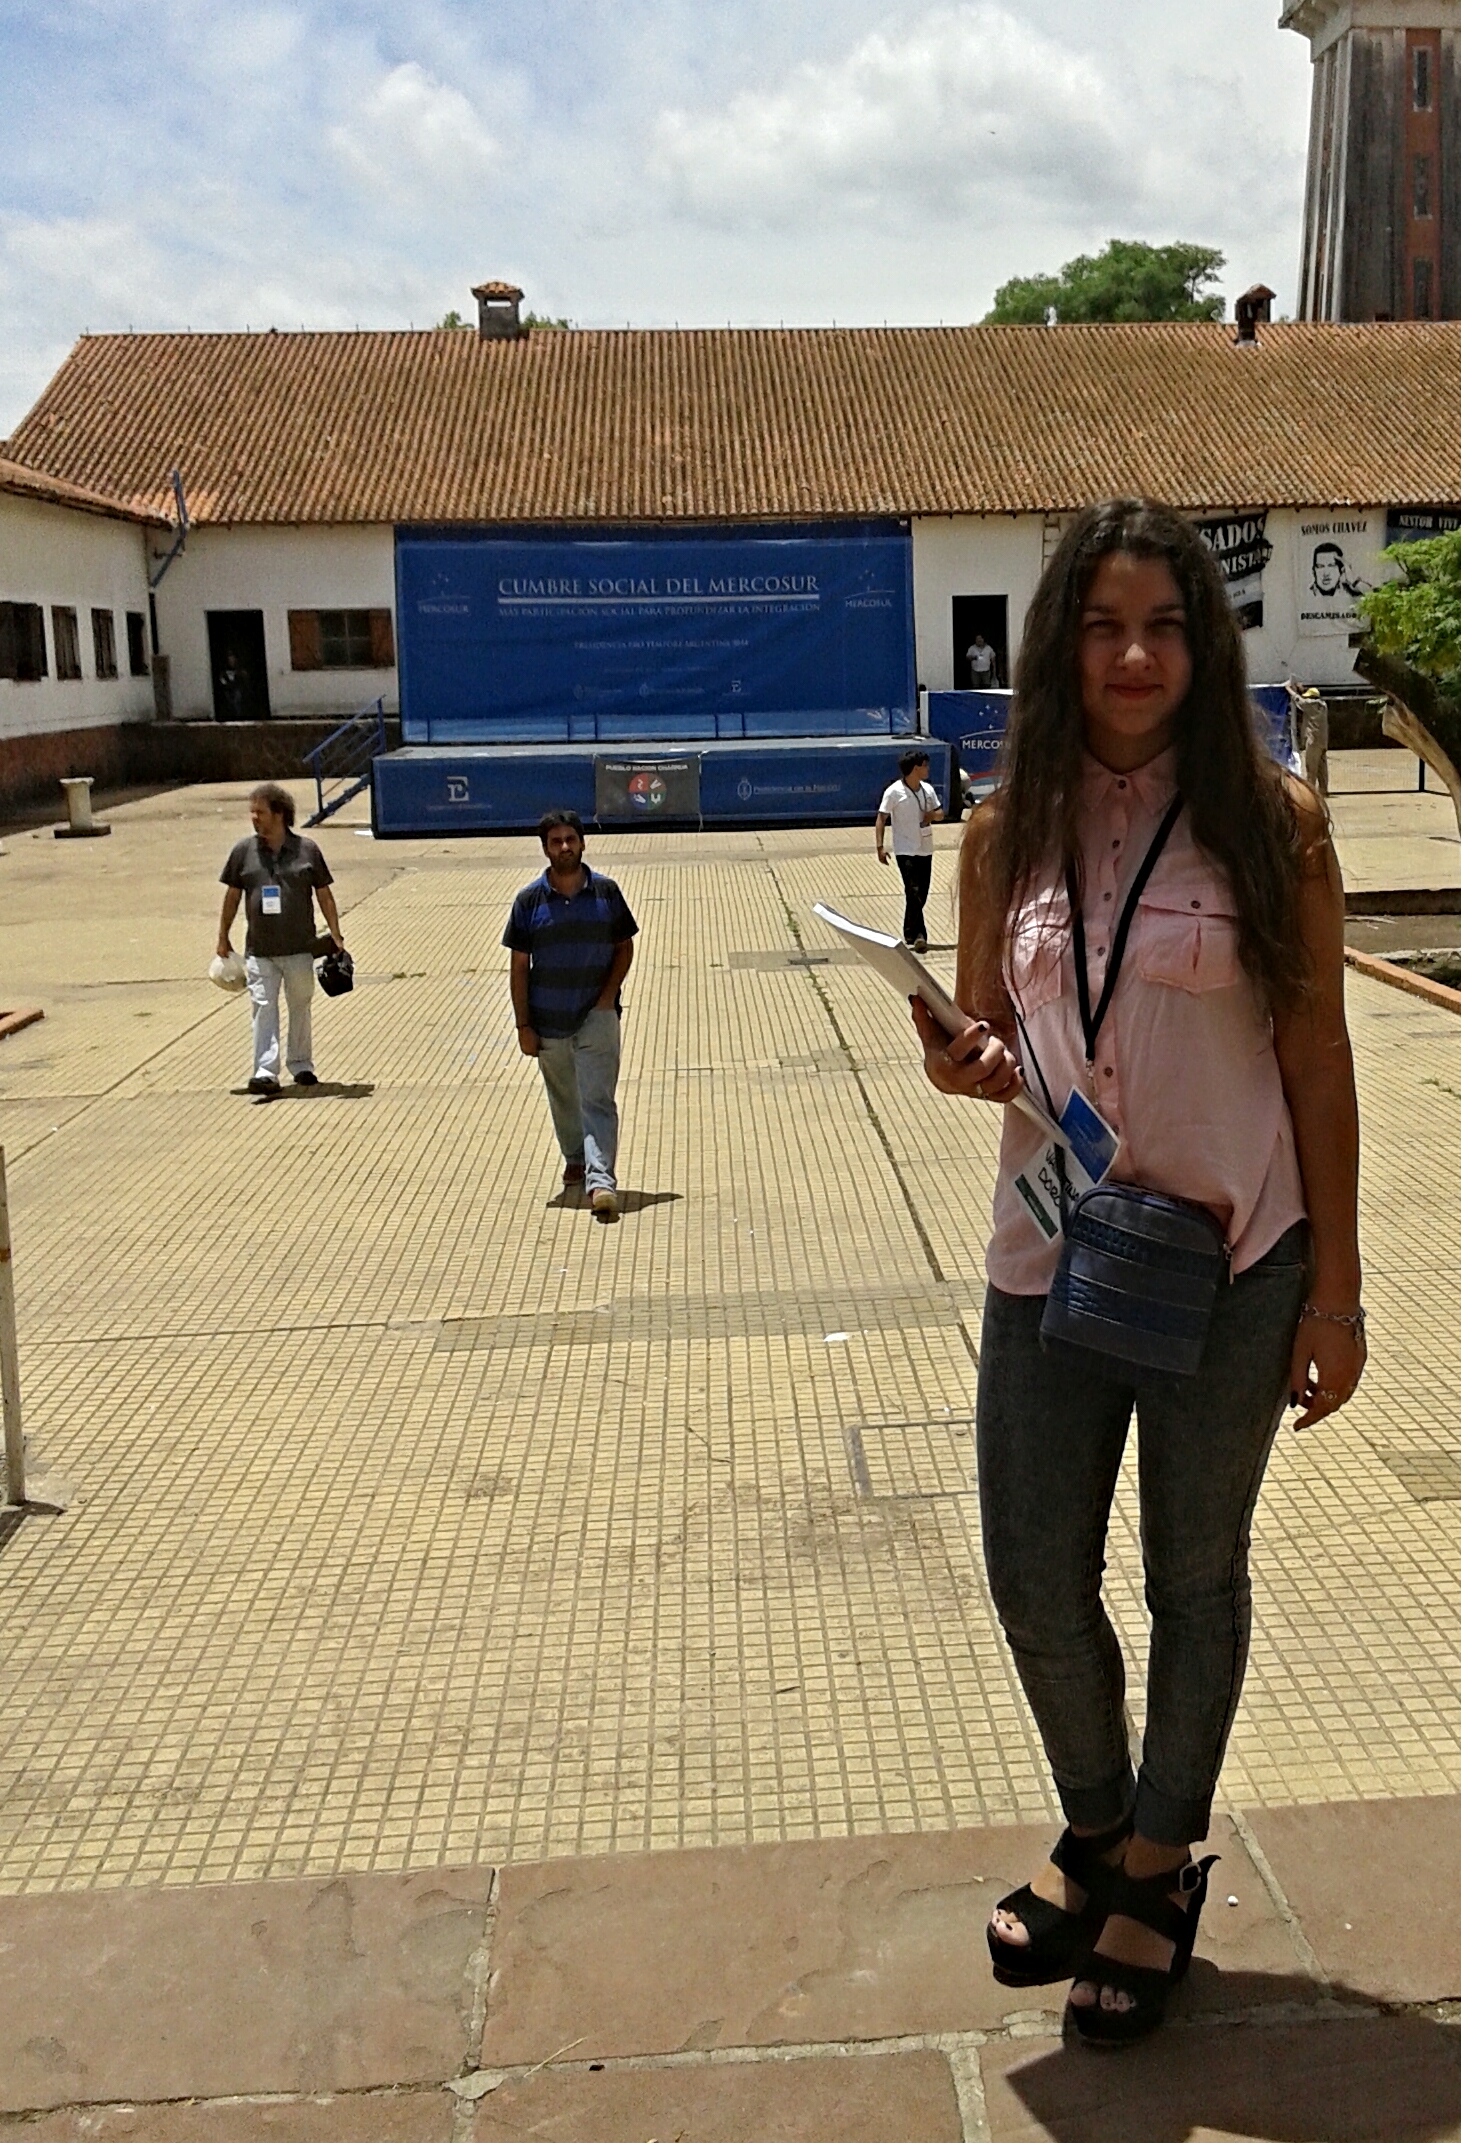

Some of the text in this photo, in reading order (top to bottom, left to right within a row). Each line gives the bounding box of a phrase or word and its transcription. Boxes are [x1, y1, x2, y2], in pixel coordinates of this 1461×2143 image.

[1301, 521, 1368, 535] SOMOS CHAVEZ
[498, 575, 819, 595] CUMBRE SOCIAL DEL MERCOSUR
[1300, 612, 1358, 620] DESCAMISADO
